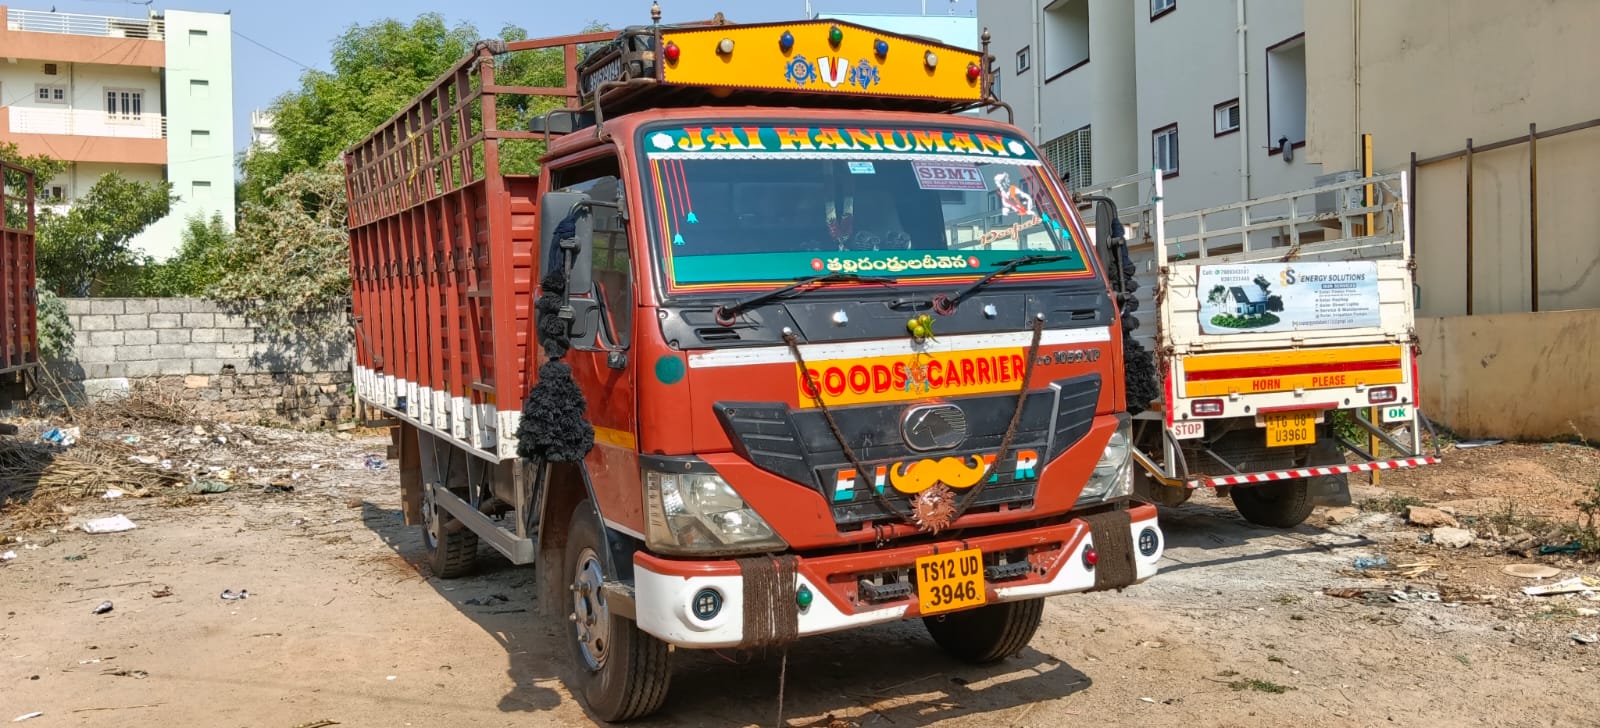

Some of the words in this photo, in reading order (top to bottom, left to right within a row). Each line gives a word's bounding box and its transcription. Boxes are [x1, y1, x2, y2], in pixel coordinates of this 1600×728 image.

[678, 127, 767, 151] JAI
[774, 127, 1010, 157] HANUMAN
[919, 167, 977, 180] SBMT
[1300, 274, 1327, 283] ENERGY
[1329, 273, 1365, 282] SOLUTIONS
[801, 360, 907, 398] GOODS
[926, 353, 1026, 388] CARRIER
[1253, 378, 1281, 391] HORN
[1312, 374, 1346, 388] PLEASE
[1294, 413, 1306, 426] 08
[1389, 408, 1406, 418] OK
[1175, 423, 1202, 436] STOP
[1276, 428, 1307, 442] U3960
[921, 559, 956, 582] TS12
[960, 556, 979, 577] UD
[930, 580, 976, 606] 3946
